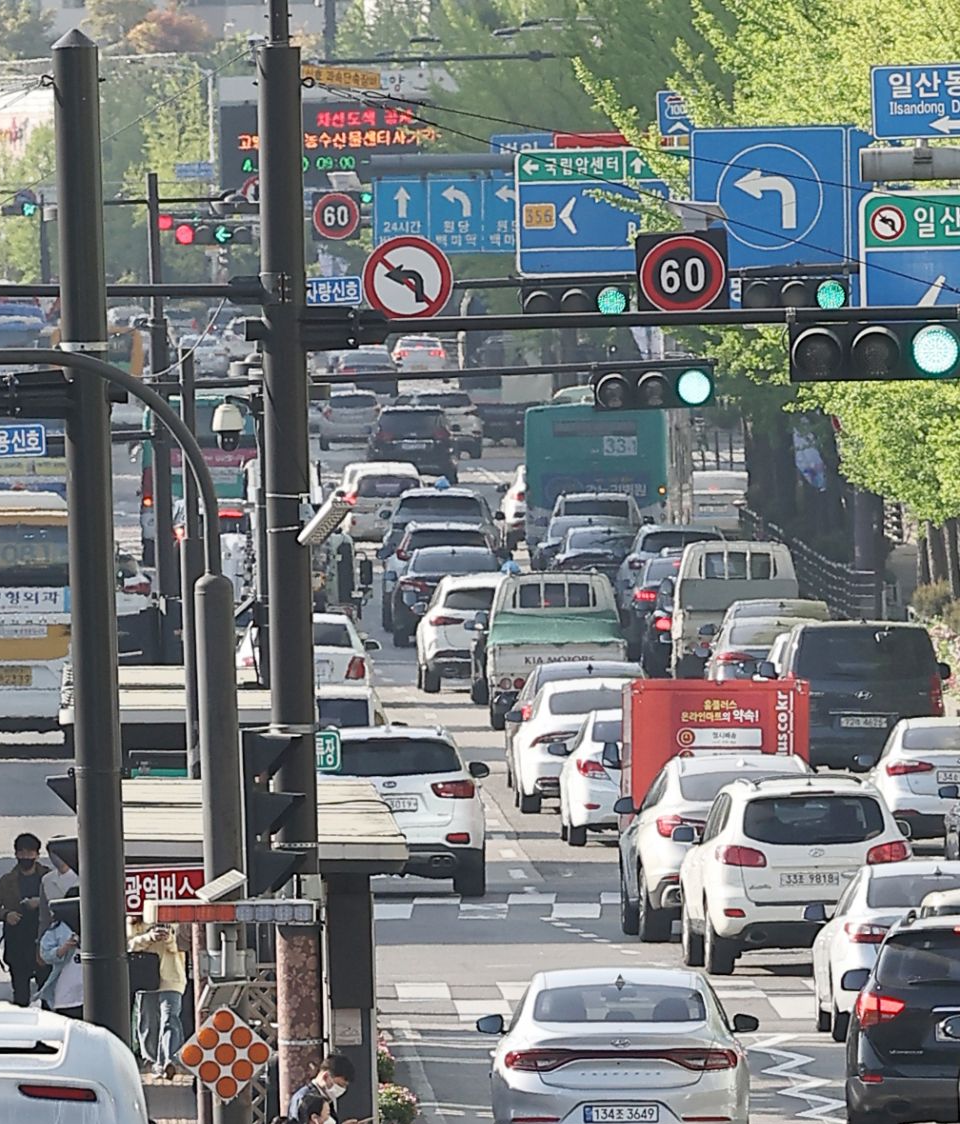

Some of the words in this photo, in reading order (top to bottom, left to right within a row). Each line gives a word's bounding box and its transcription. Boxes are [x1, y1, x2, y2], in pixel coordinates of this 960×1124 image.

[889, 101, 945, 117] Ilsandong
[544, 156, 619, 176] 국립암센터
[323, 205, 349, 227] 60
[525, 207, 554, 224] 356
[382, 220, 422, 234] 24시간
[660, 256, 705, 294] 60
[524, 655, 543, 665] KIA
[703, 699, 738, 711] 홈플러스
[732, 708, 760, 724] 약속!
[125, 873, 195, 910] 광역버스
[594, 1107, 624, 1120] 134조
[626, 1107, 655, 1120] 3649
